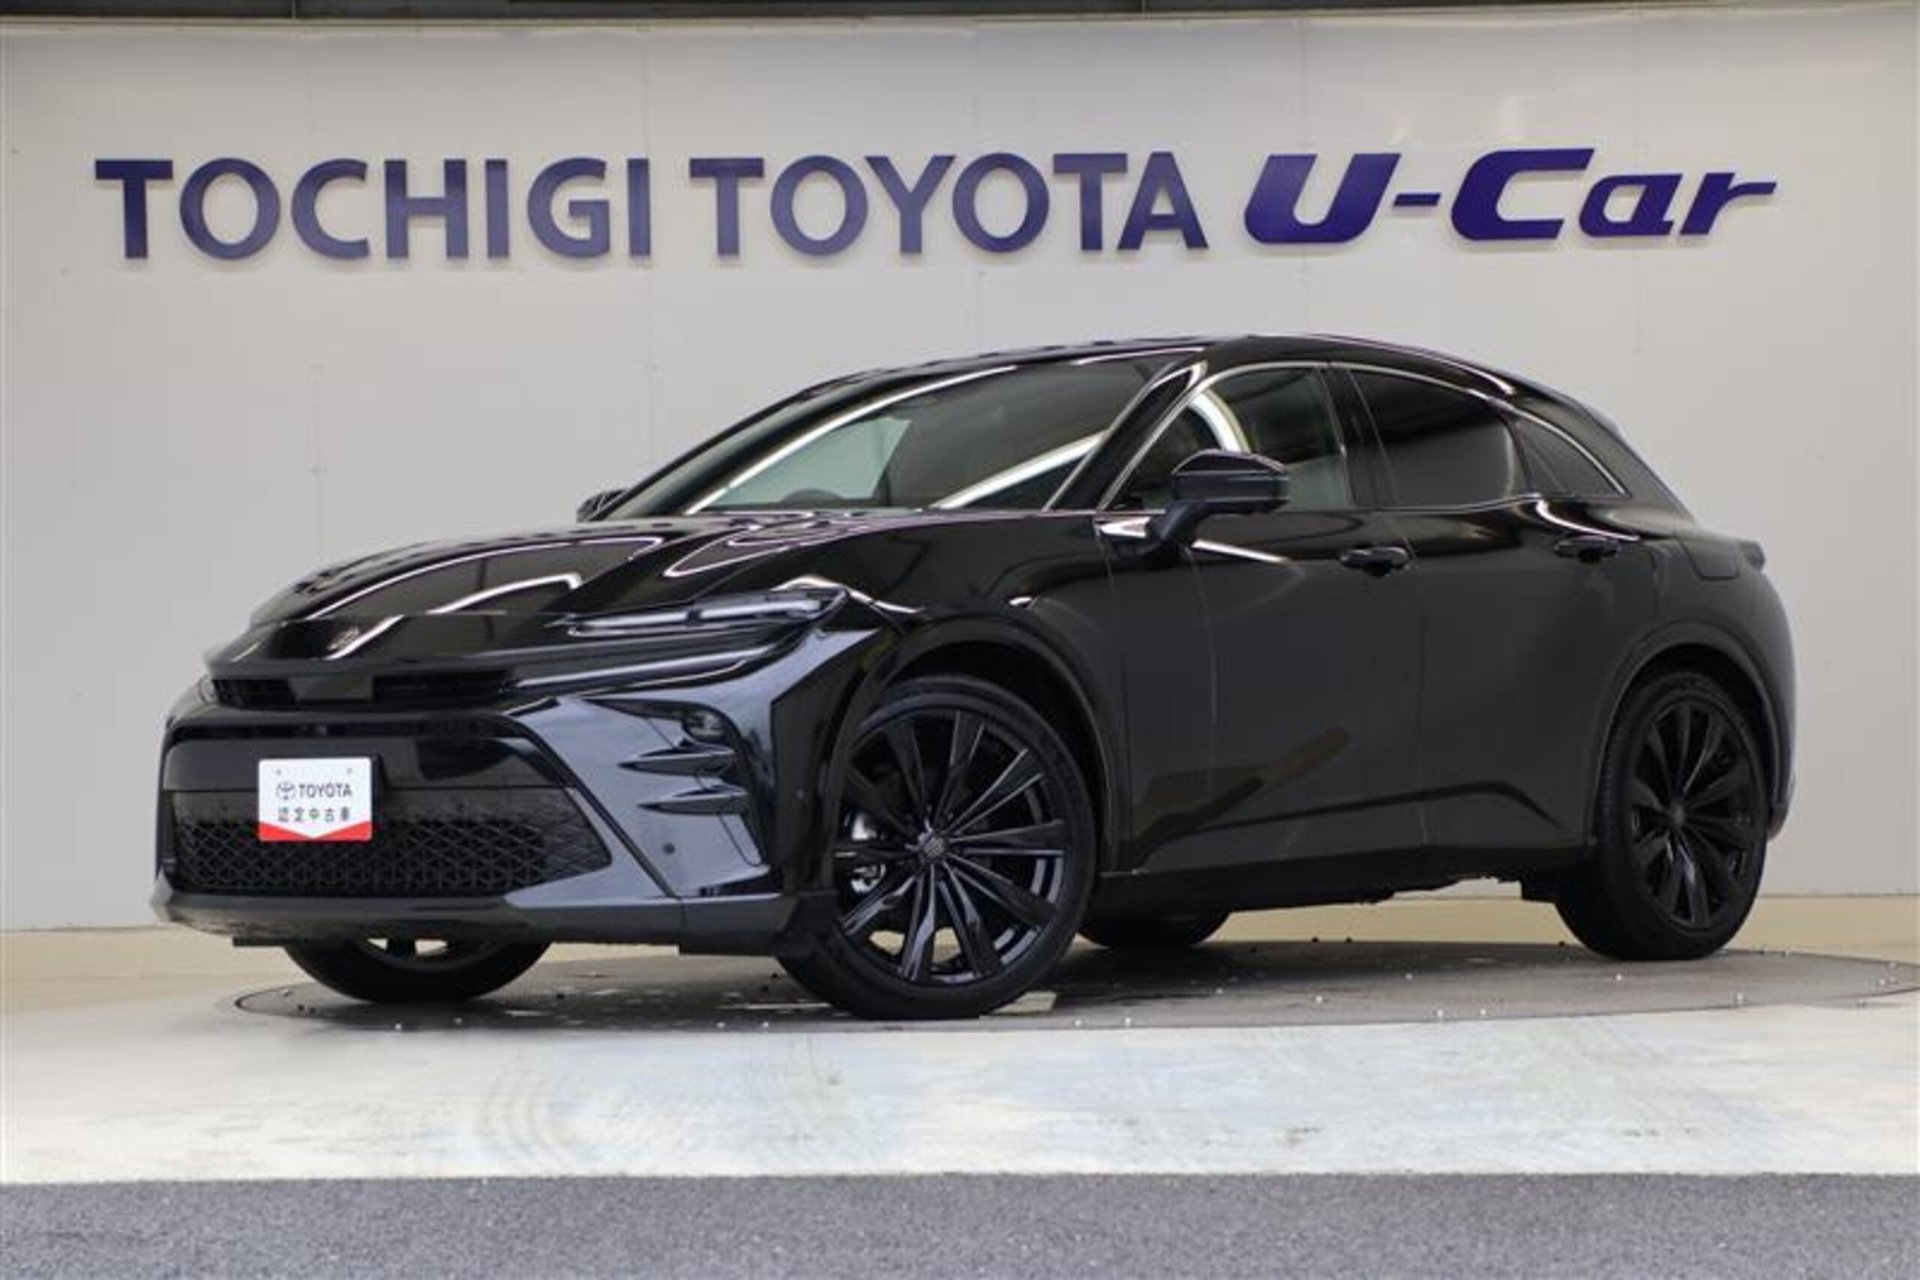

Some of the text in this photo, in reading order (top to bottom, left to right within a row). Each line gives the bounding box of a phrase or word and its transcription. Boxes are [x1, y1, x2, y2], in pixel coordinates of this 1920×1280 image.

[95, 148, 1777, 260] TOCHIGI TOYOTA U-Car
[298, 782, 352, 798] TOYOTA
